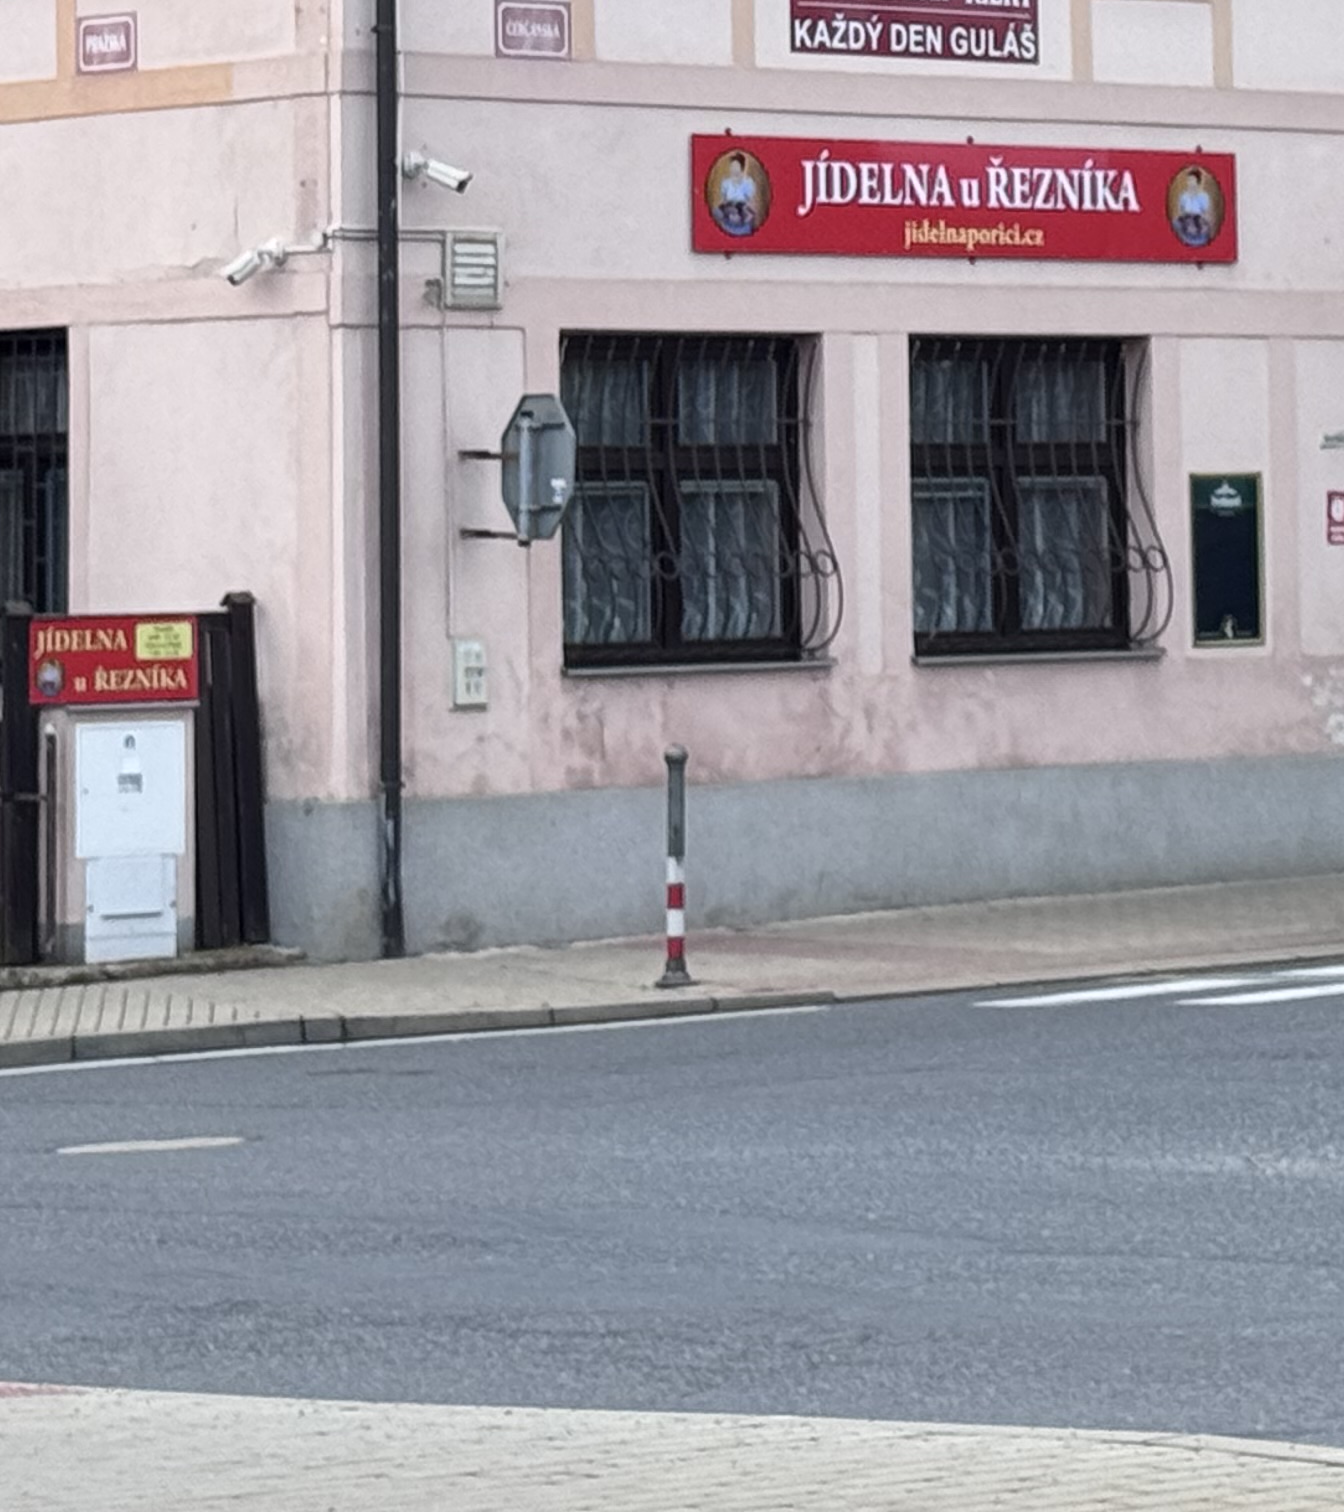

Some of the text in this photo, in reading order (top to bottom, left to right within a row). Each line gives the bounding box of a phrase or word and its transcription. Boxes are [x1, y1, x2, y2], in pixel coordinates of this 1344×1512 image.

[794, 13, 1036, 59] KAŽDÝ DEN GULÁŠ
[797, 150, 1140, 216] JÍDELNA u ŘEZNÍKA
[34, 626, 127, 660] JÍDELNA
[74, 664, 187, 693] u ŘEZNÍKA
